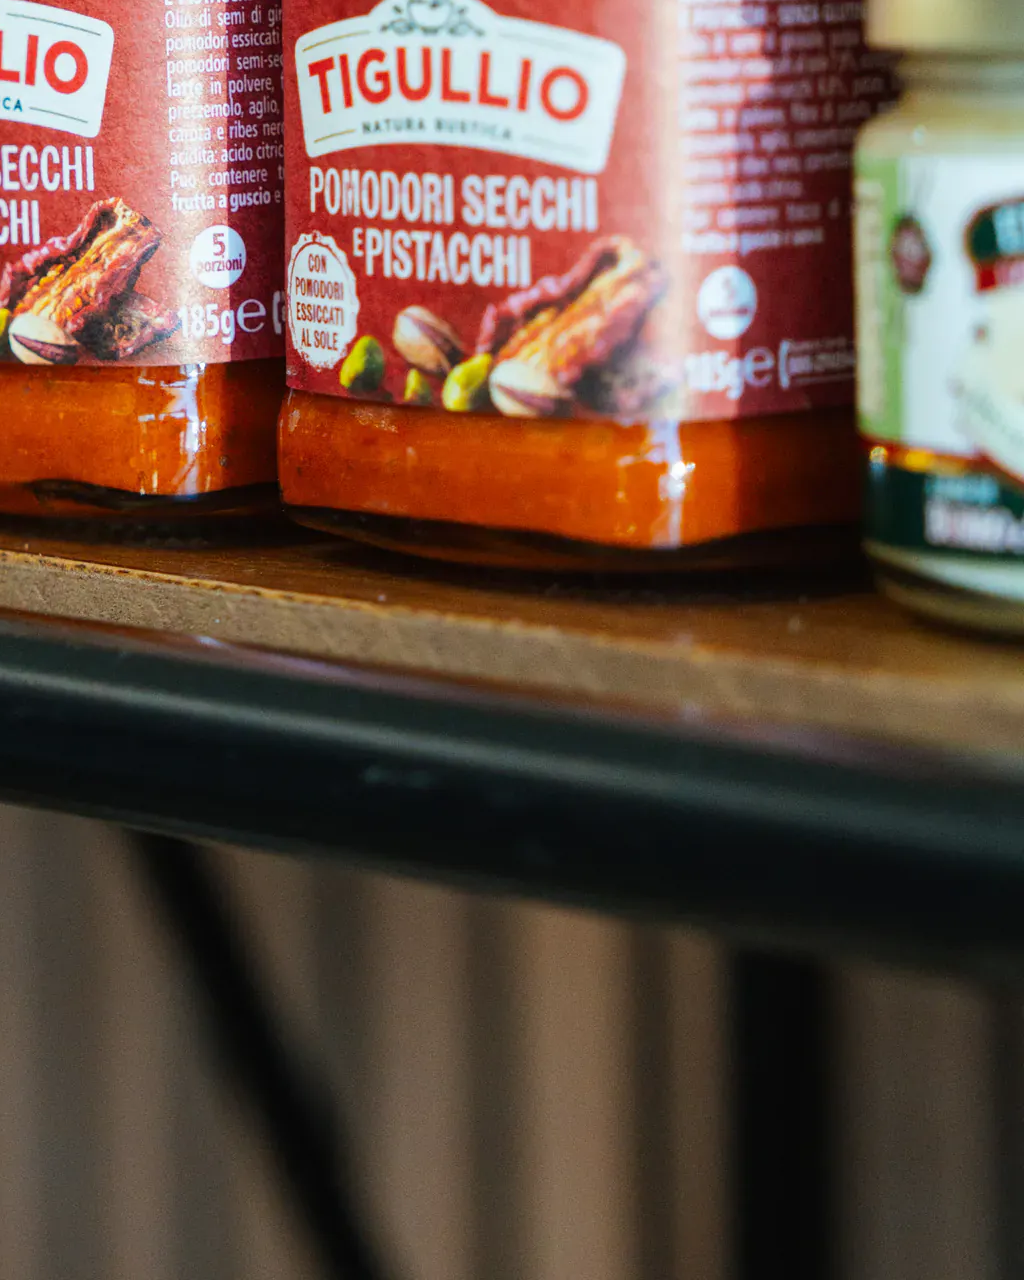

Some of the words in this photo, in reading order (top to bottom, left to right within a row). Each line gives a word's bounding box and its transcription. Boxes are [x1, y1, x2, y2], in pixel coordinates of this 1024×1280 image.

[199, 7, 211, 27] di
[217, 5, 245, 27] semi
[251, 4, 262, 24] di
[166, 30, 229, 56] pomodori
[232, 26, 280, 48] essiccati
[167, 52, 230, 80] pomodori
[210, 75, 222, 95] in
[228, 73, 275, 100] polvere,
[308, 46, 590, 123] TIGULLIO
[249, 96, 279, 119] aglio,
[217, 125, 224, 141] e
[229, 120, 258, 140] ribes
[362, 117, 425, 135] NATURA
[221, 142, 253, 163] acido
[208, 168, 268, 187] contenere
[219, 193, 228, 209] a
[229, 186, 271, 212] guscio
[274, 189, 281, 203] e
[310, 166, 454, 225] POMODORI
[462, 175, 598, 233] SECCHI
[212, 232, 226, 257] 5
[308, 253, 327, 273] CON
[353, 227, 364, 257] E
[365, 229, 531, 288] PISTACCHI
[295, 276, 344, 301] POMODORI
[296, 301, 344, 326] ESSICCATI
[301, 327, 312, 348] AL
[314, 330, 339, 351] SOLE
